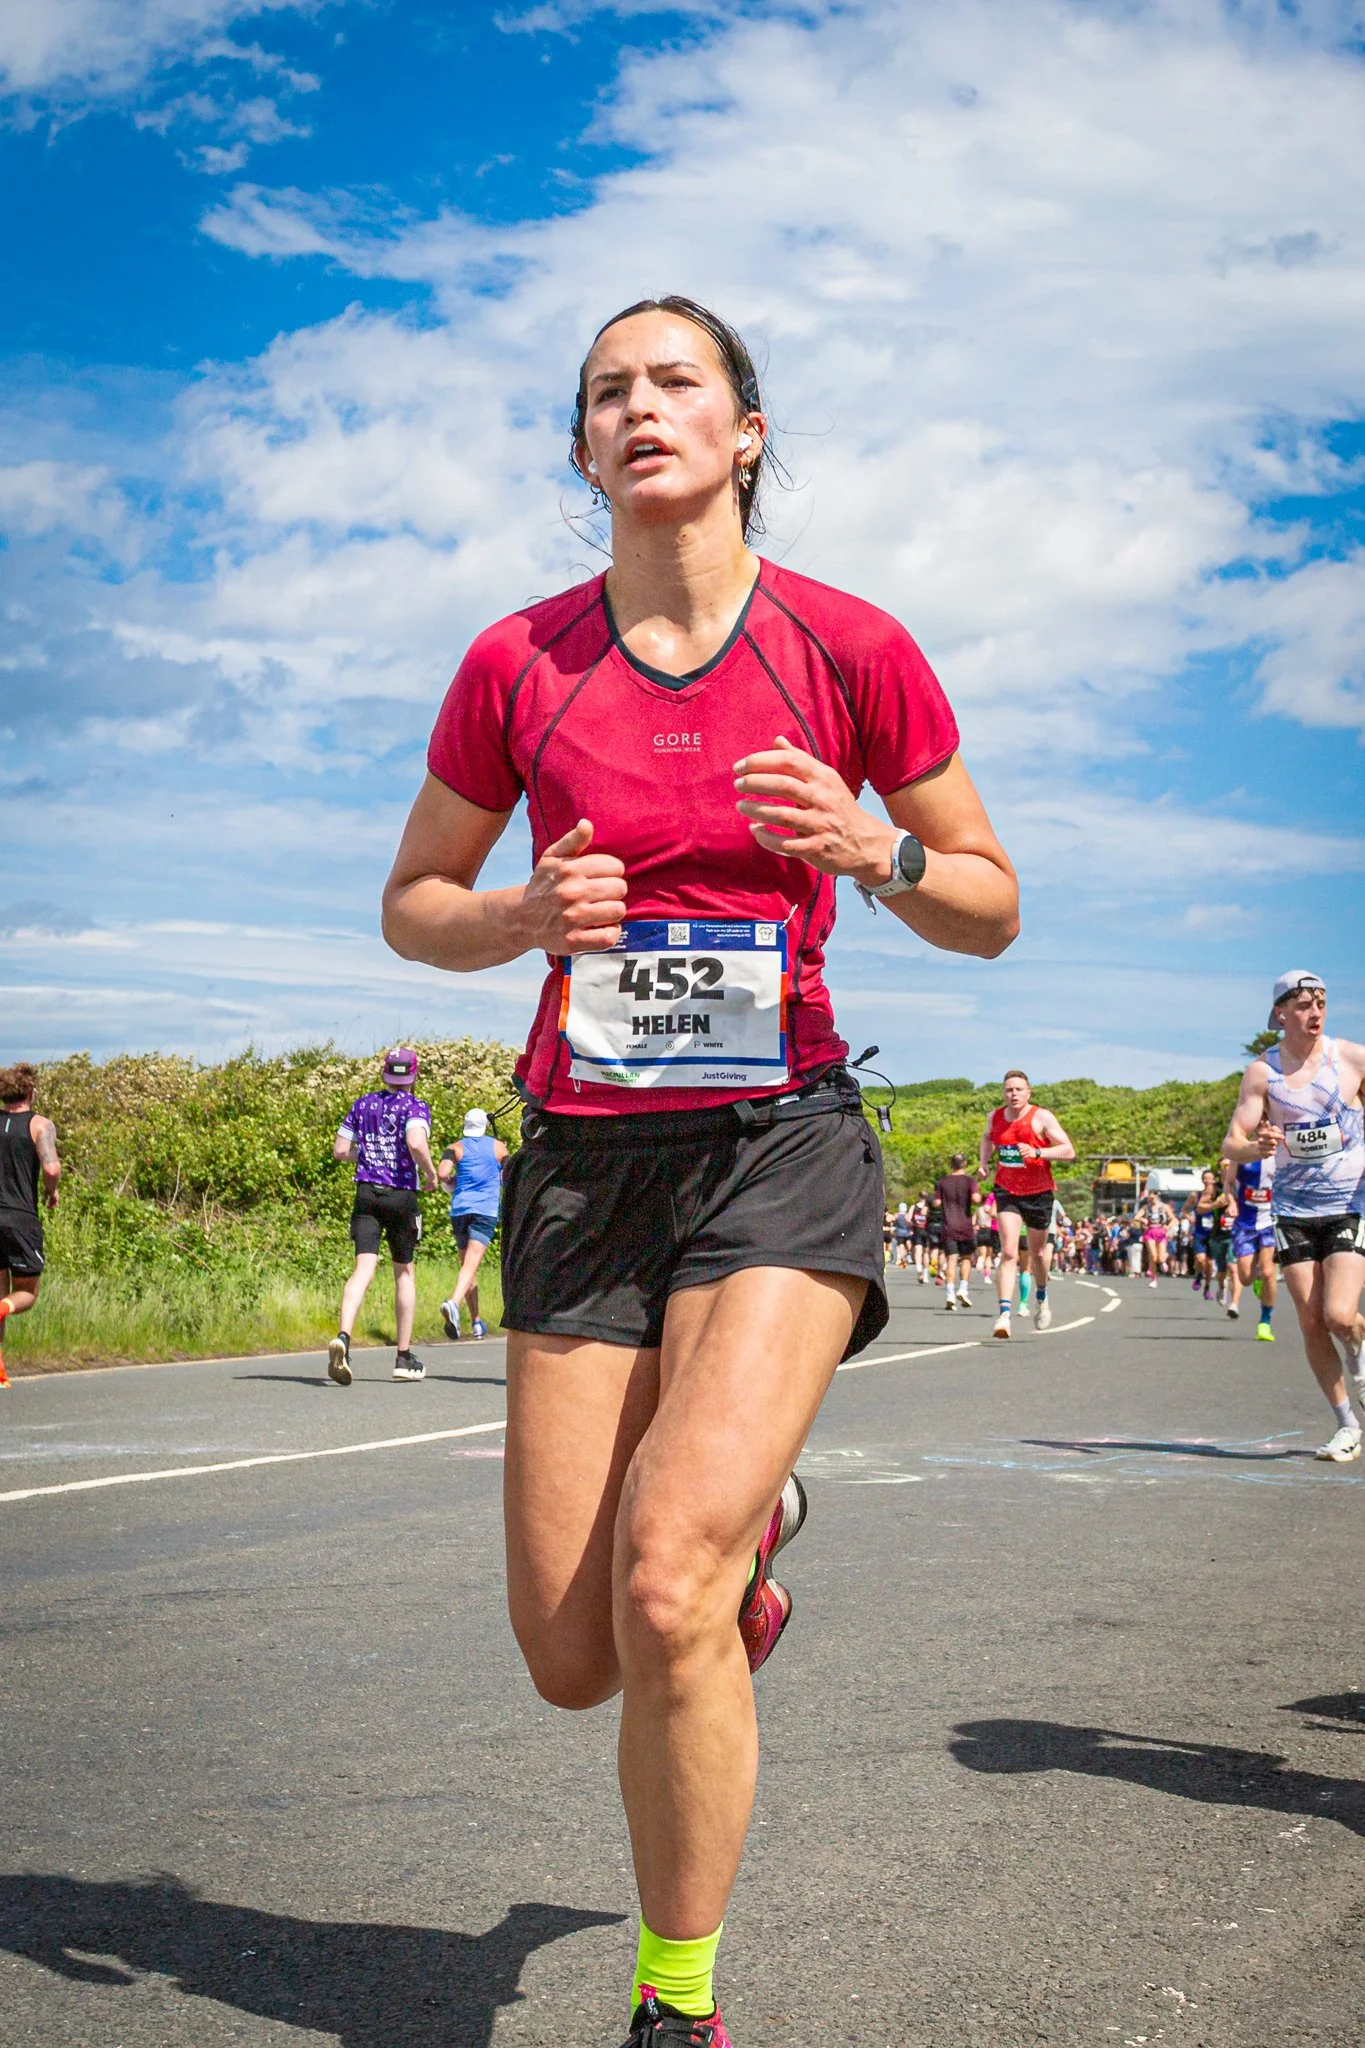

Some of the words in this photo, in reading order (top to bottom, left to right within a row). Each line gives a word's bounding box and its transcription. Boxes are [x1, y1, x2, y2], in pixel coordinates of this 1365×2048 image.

[653, 732, 702, 746] GORE
[618, 956, 725, 1001] 452
[632, 1013, 711, 1036] HELEN
[701, 1072, 747, 1082] JustGiving
[1296, 1130, 1327, 1144] 484
[1300, 1144, 1328, 1152] ROBERT
